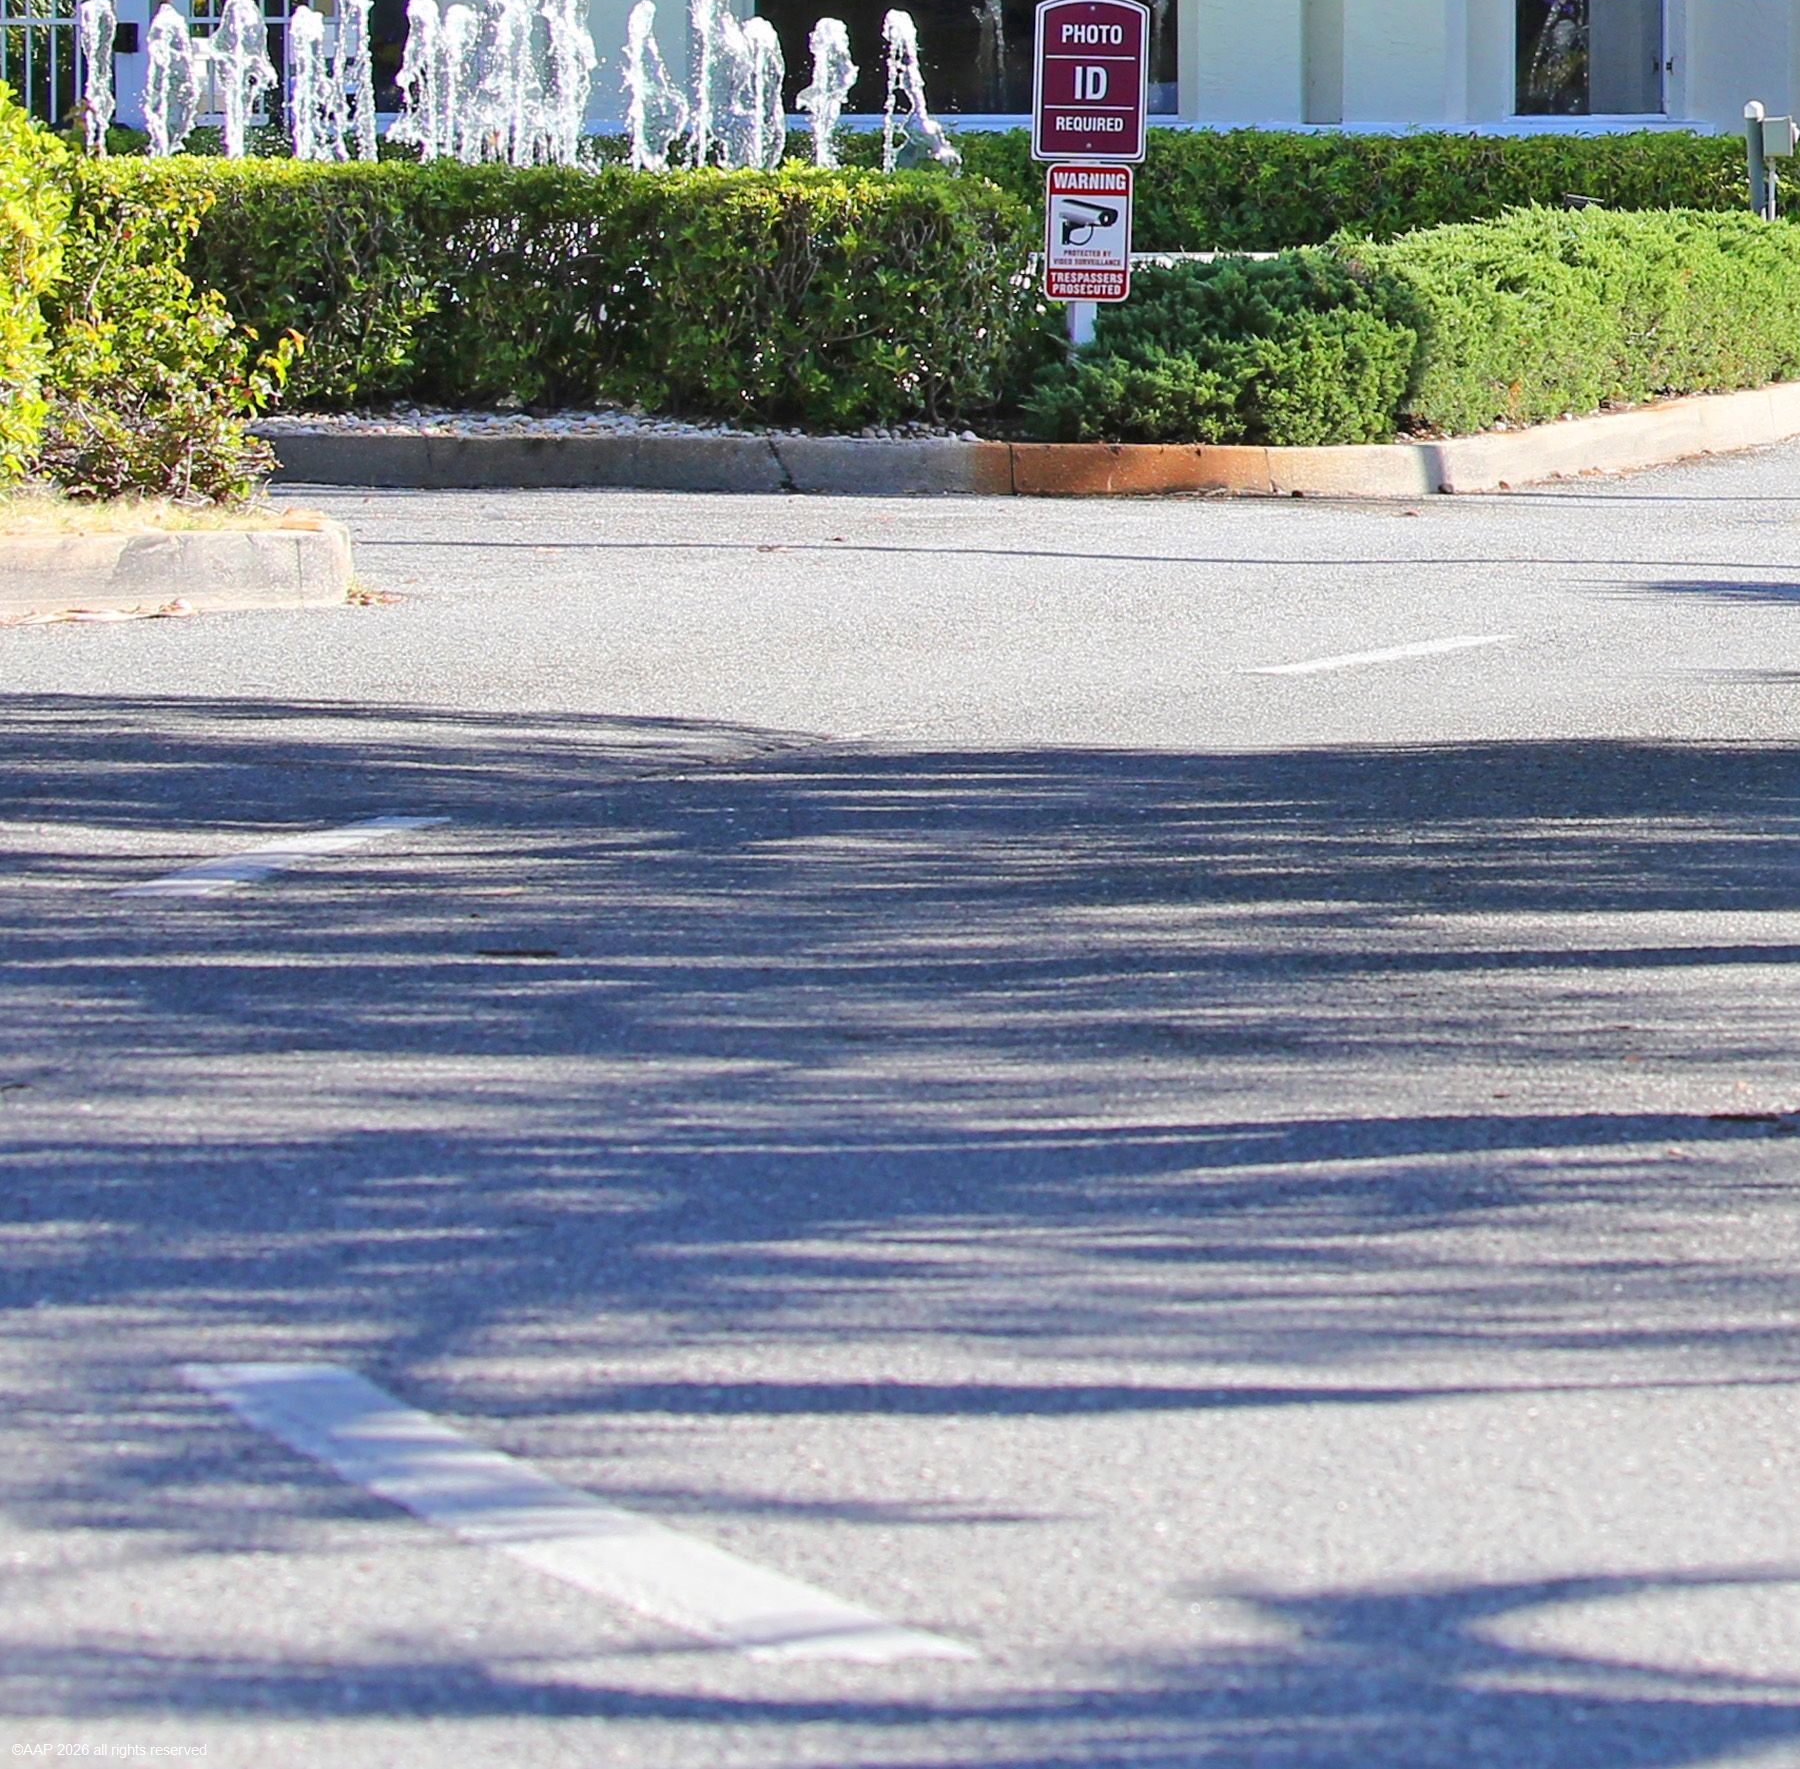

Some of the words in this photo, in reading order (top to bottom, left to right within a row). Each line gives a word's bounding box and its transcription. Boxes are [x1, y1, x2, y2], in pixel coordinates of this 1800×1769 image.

[1061, 24, 1123, 45] PHOTO
[1074, 66, 1108, 100] ID
[1056, 116, 1124, 132] REQUIRED
[1053, 172, 1127, 190] WARNING
[1050, 272, 1124, 284] TRESPASSERS
[1052, 283, 1121, 295] PROSECUTED
